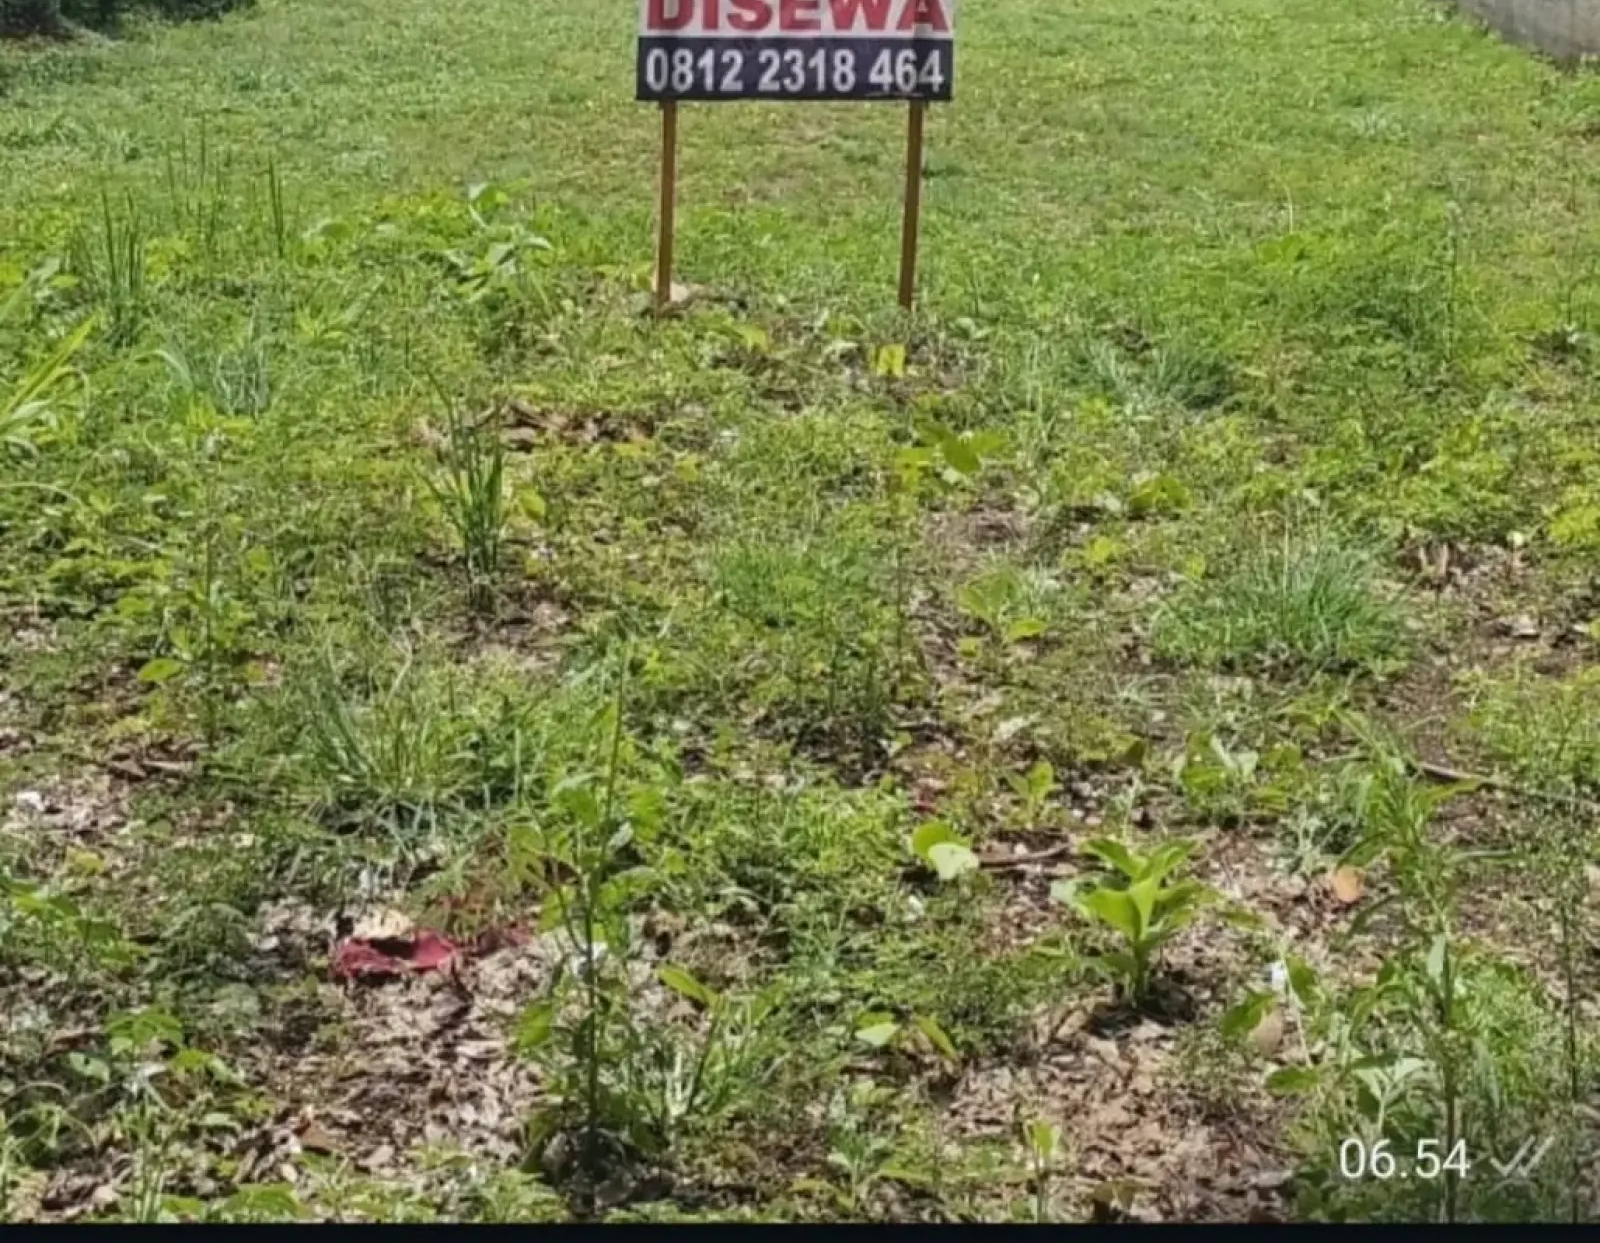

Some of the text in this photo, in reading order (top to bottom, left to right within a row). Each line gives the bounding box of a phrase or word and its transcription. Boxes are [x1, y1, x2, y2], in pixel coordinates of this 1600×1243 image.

[645, 48, 945, 92] 0812 2318 464
